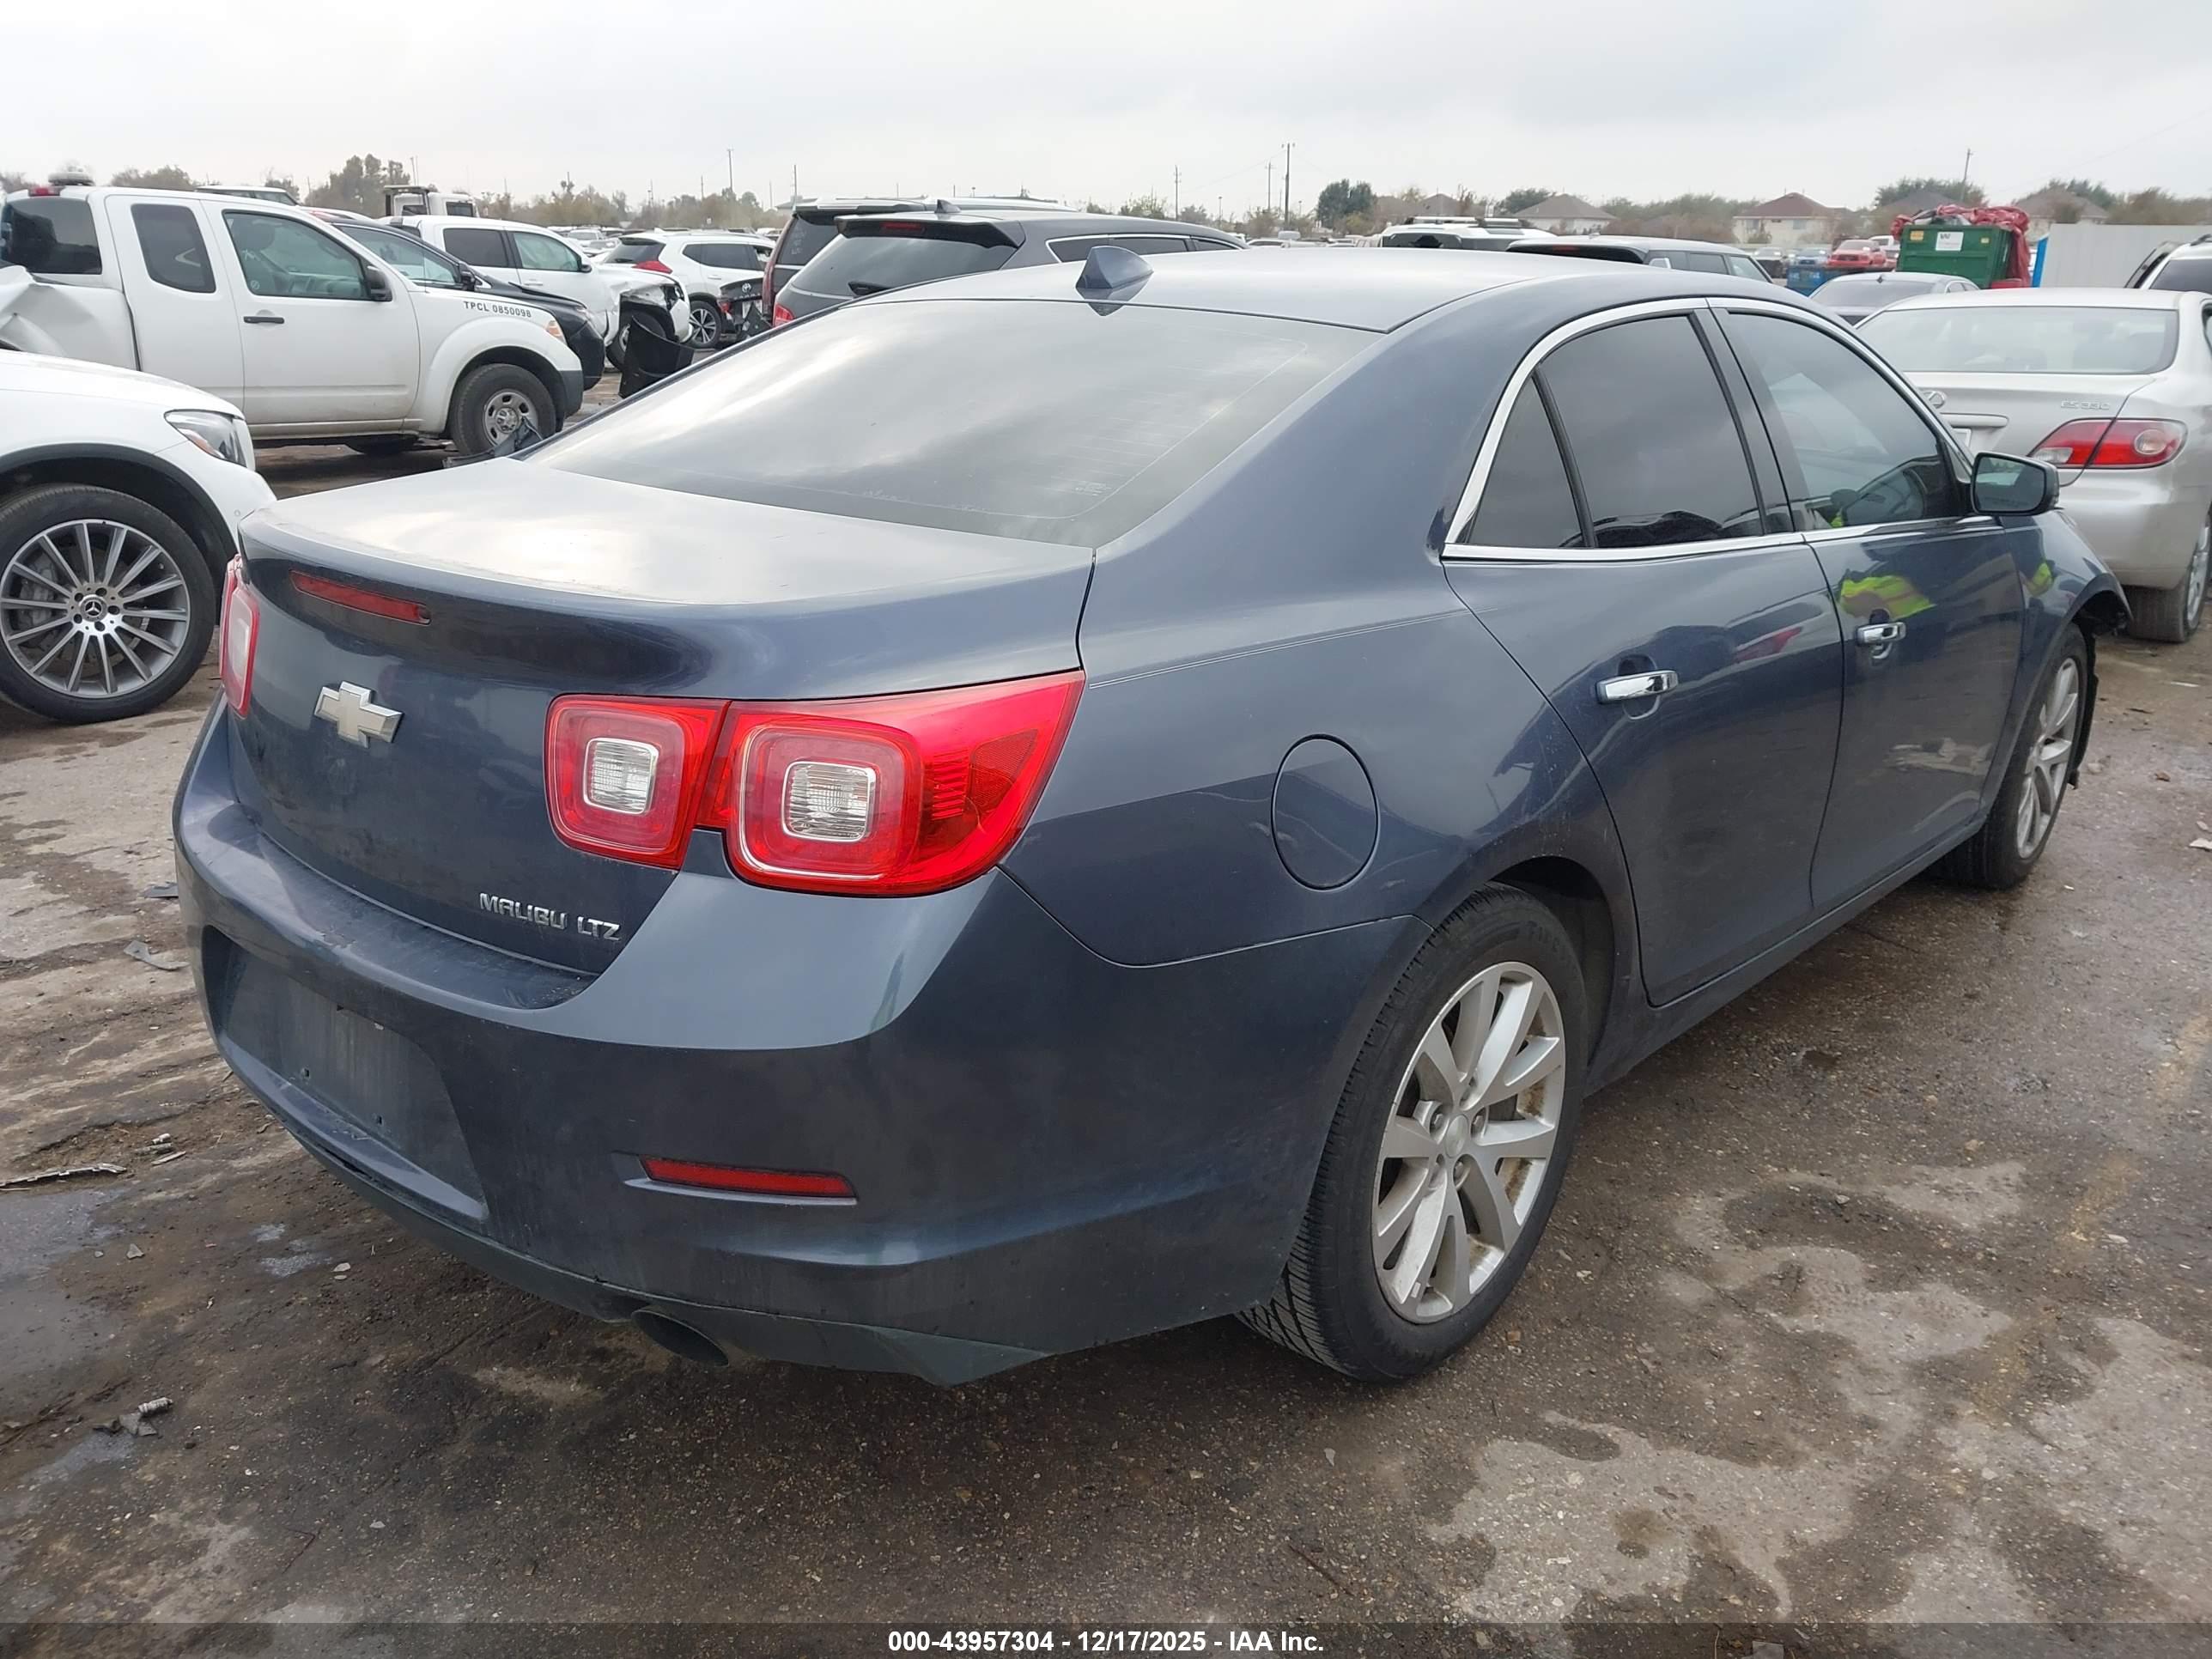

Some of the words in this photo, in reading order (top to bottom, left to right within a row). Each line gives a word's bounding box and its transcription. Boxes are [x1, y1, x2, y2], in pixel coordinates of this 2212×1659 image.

[463, 301, 489, 312] TPCL
[492, 304, 532, 318] 0850098
[479, 892, 568, 930] MALIBU
[577, 916, 622, 941] LTZ
